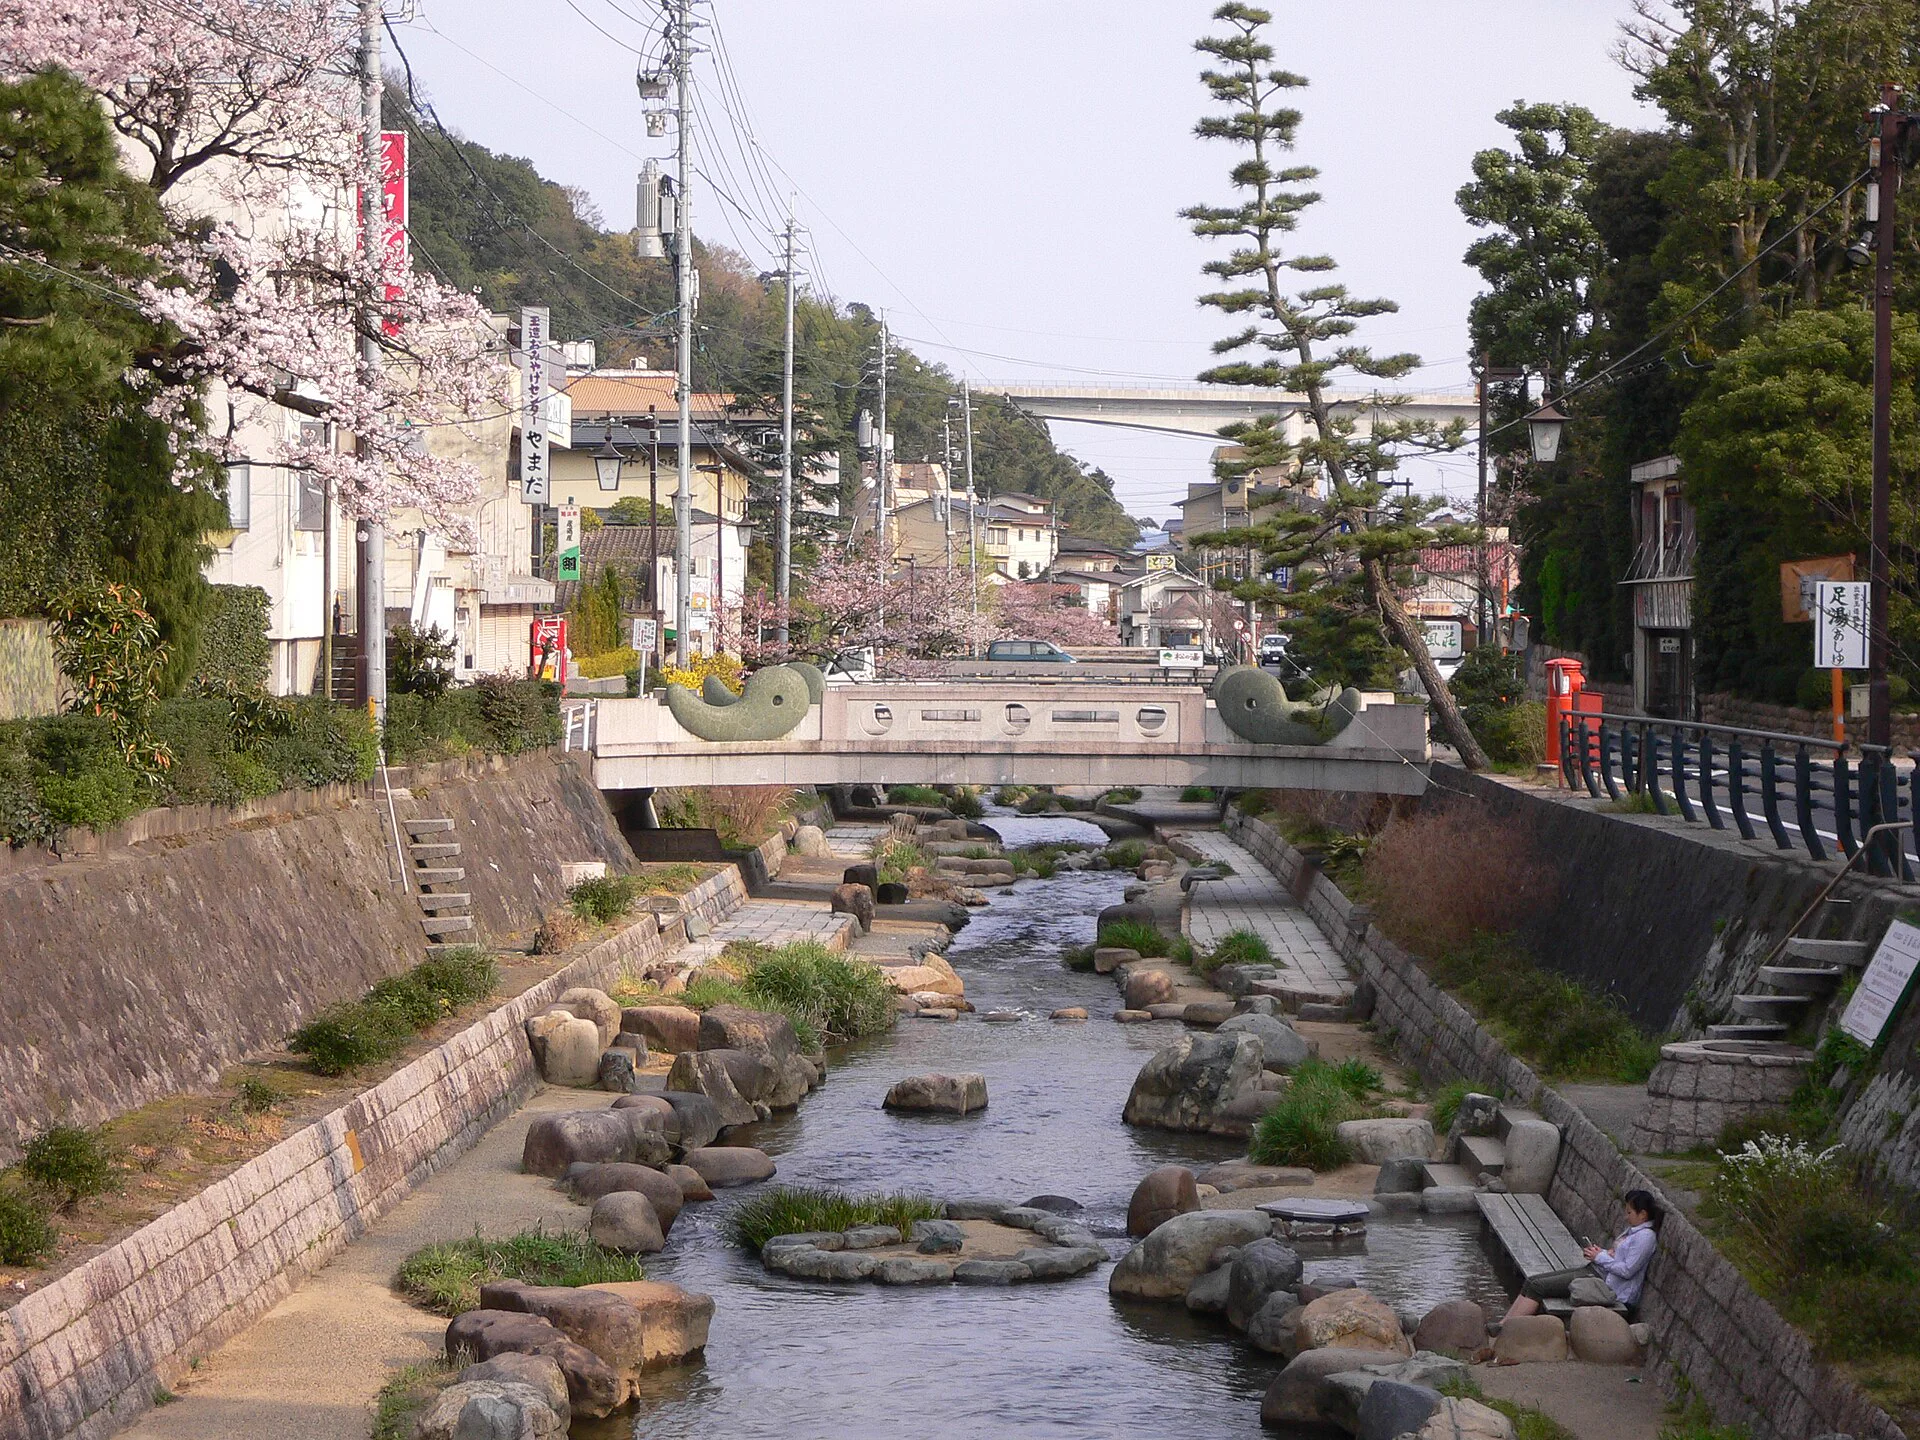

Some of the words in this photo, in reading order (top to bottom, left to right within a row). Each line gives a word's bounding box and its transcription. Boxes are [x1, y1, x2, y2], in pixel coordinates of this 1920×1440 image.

[528, 316, 544, 425] 玉造おみやげセンター
[525, 430, 543, 495] やまだ
